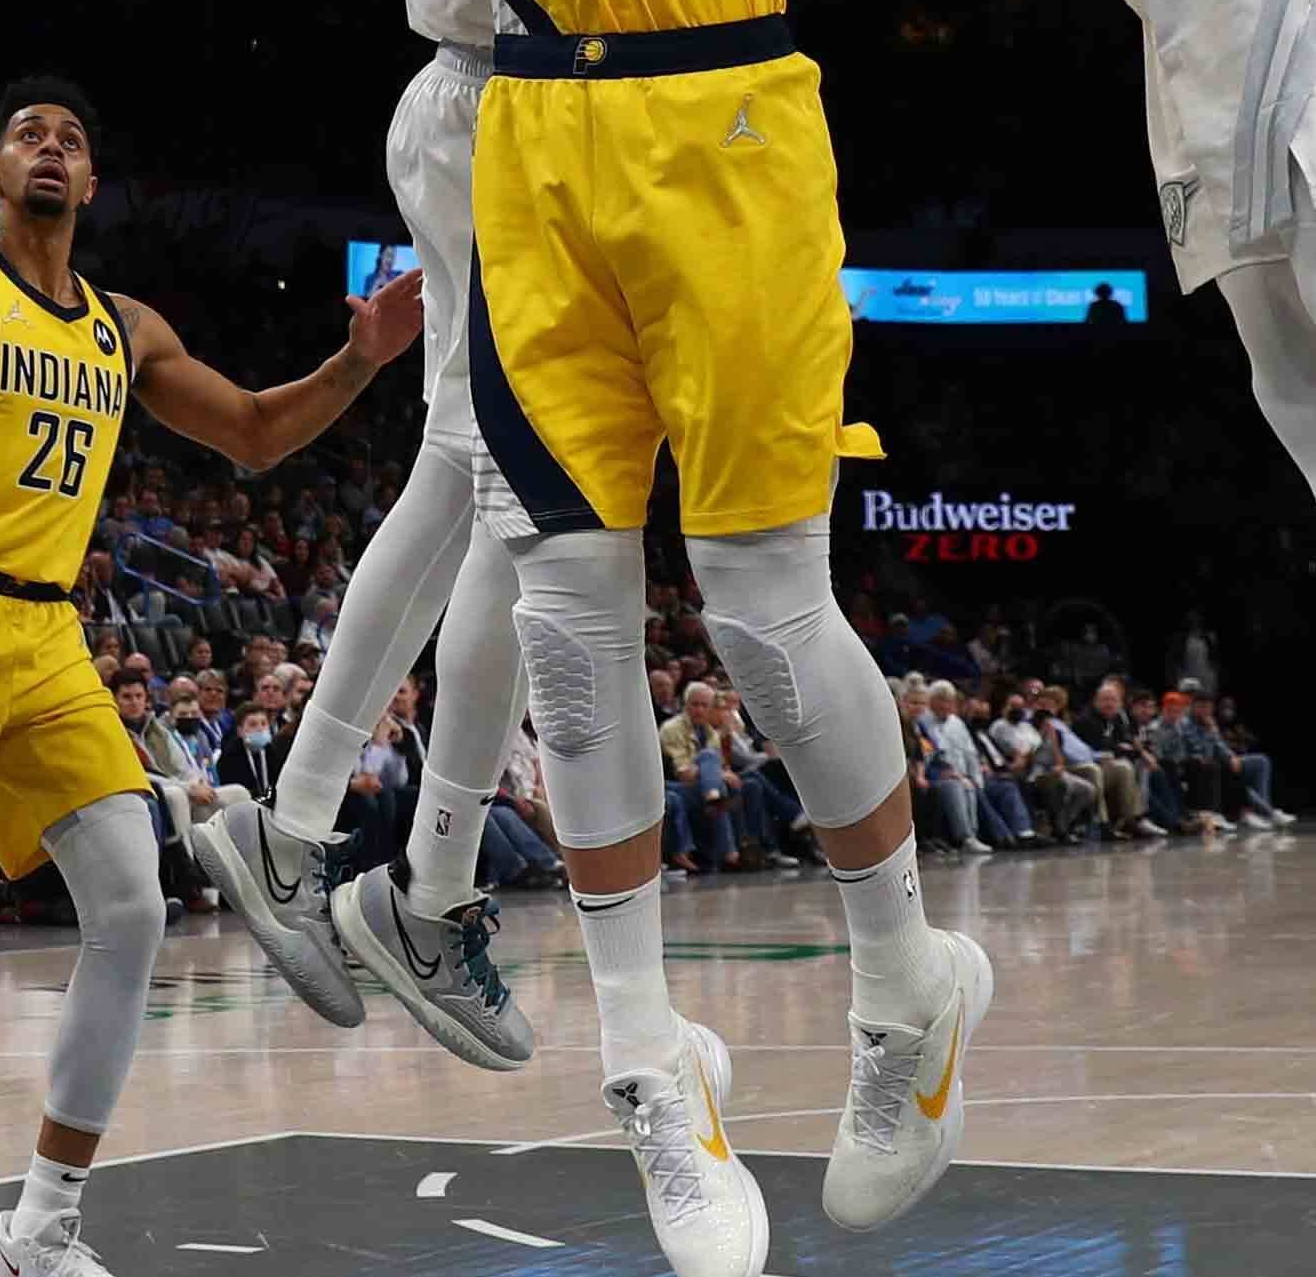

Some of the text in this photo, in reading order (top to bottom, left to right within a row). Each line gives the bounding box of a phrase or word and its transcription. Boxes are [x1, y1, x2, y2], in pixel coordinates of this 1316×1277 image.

[16, 410, 94, 499] 26
[862, 489, 1076, 532] Budweiser
[903, 533, 1040, 562] ZERO
